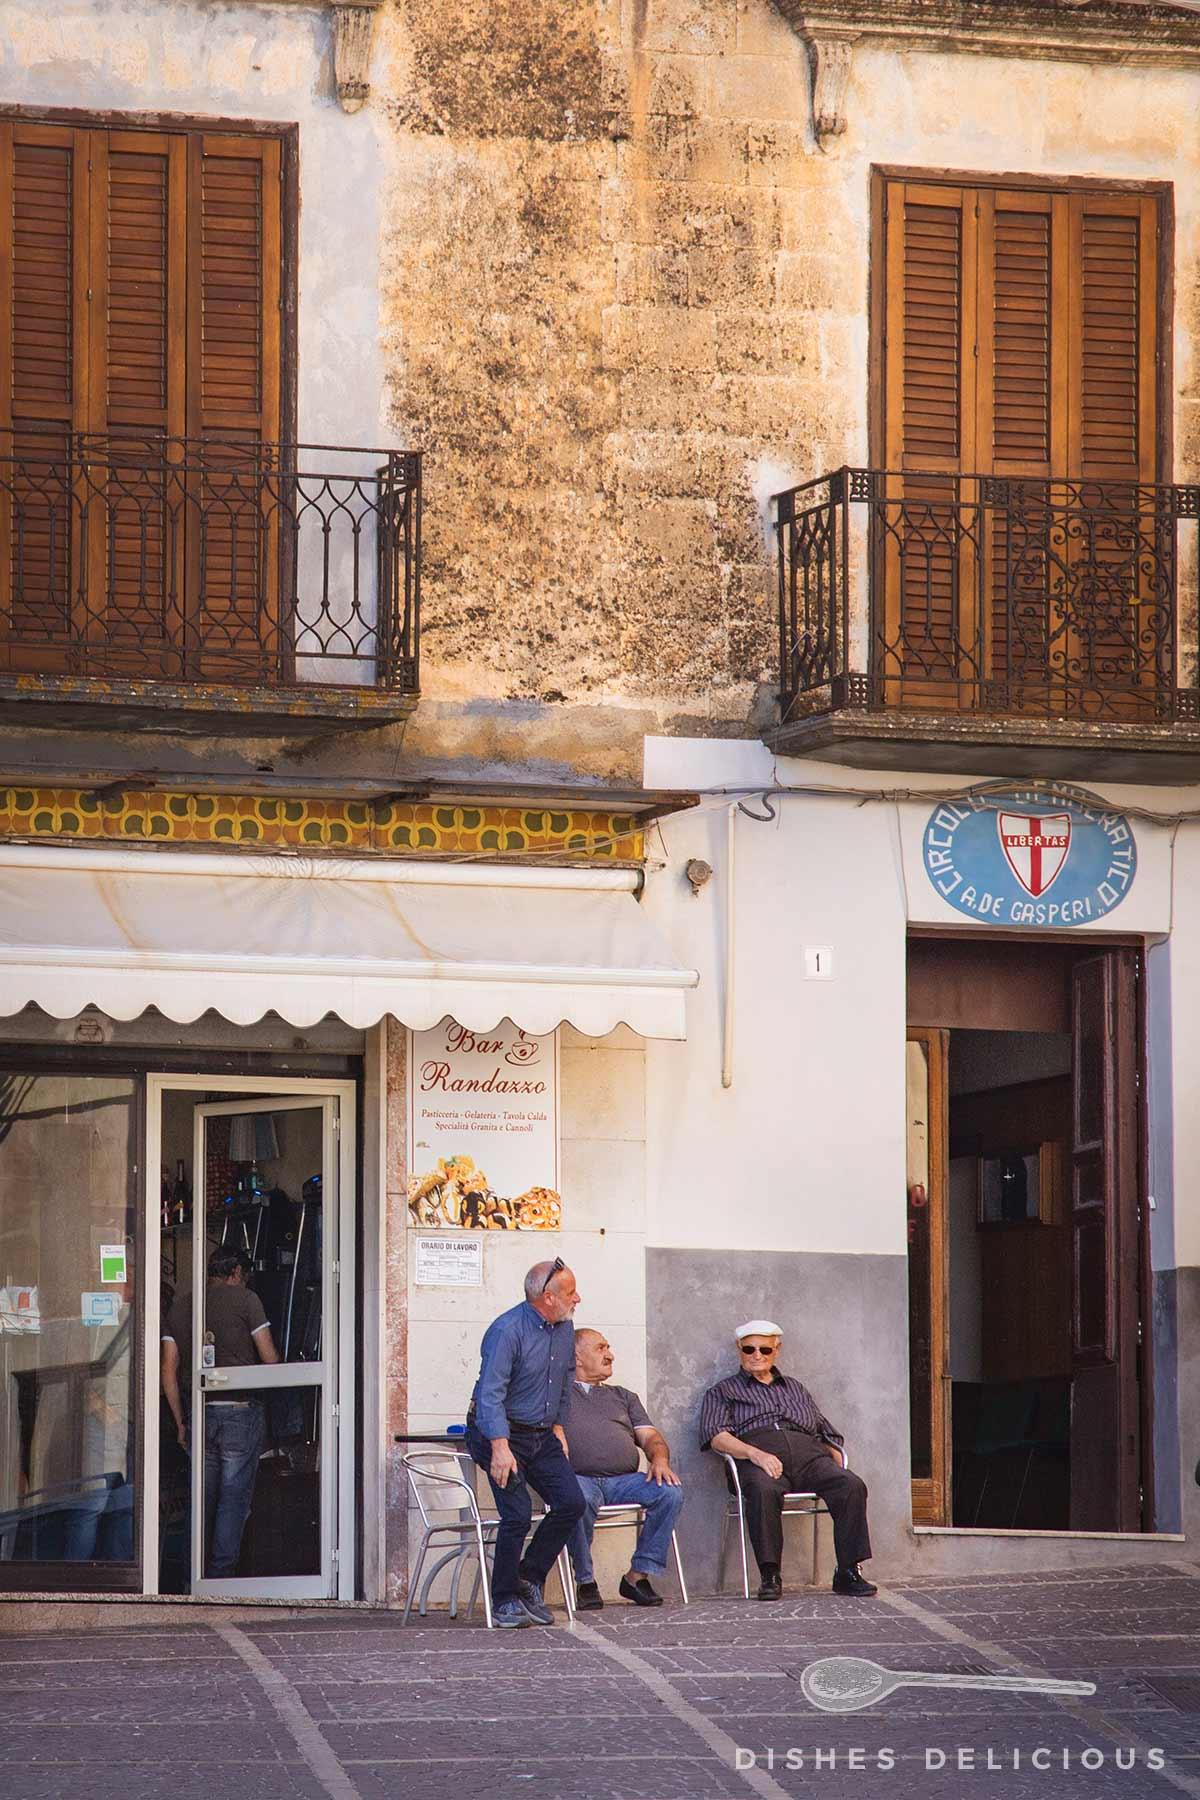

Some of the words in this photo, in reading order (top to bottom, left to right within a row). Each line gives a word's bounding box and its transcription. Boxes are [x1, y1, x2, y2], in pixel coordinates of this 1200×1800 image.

[1006, 835, 1068, 847] LIBERTAS
[1010, 897, 1092, 924] GASPERI
[445, 1020, 504, 1054] Bar
[420, 1060, 547, 1095] Randazzo
[421, 1109, 459, 1119] Pasticceria
[464, 1110, 497, 1120] Gelateria
[502, 1111, 526, 1120] Tavola
[527, 1111, 547, 1121] Calda
[470, 1121, 498, 1131] Granita
[505, 1122, 534, 1132] Cannoli
[421, 1242, 445, 1250] ORARIO
[445, 1242, 452, 1250] DI
[453, 1243, 478, 1251] LAVORO
